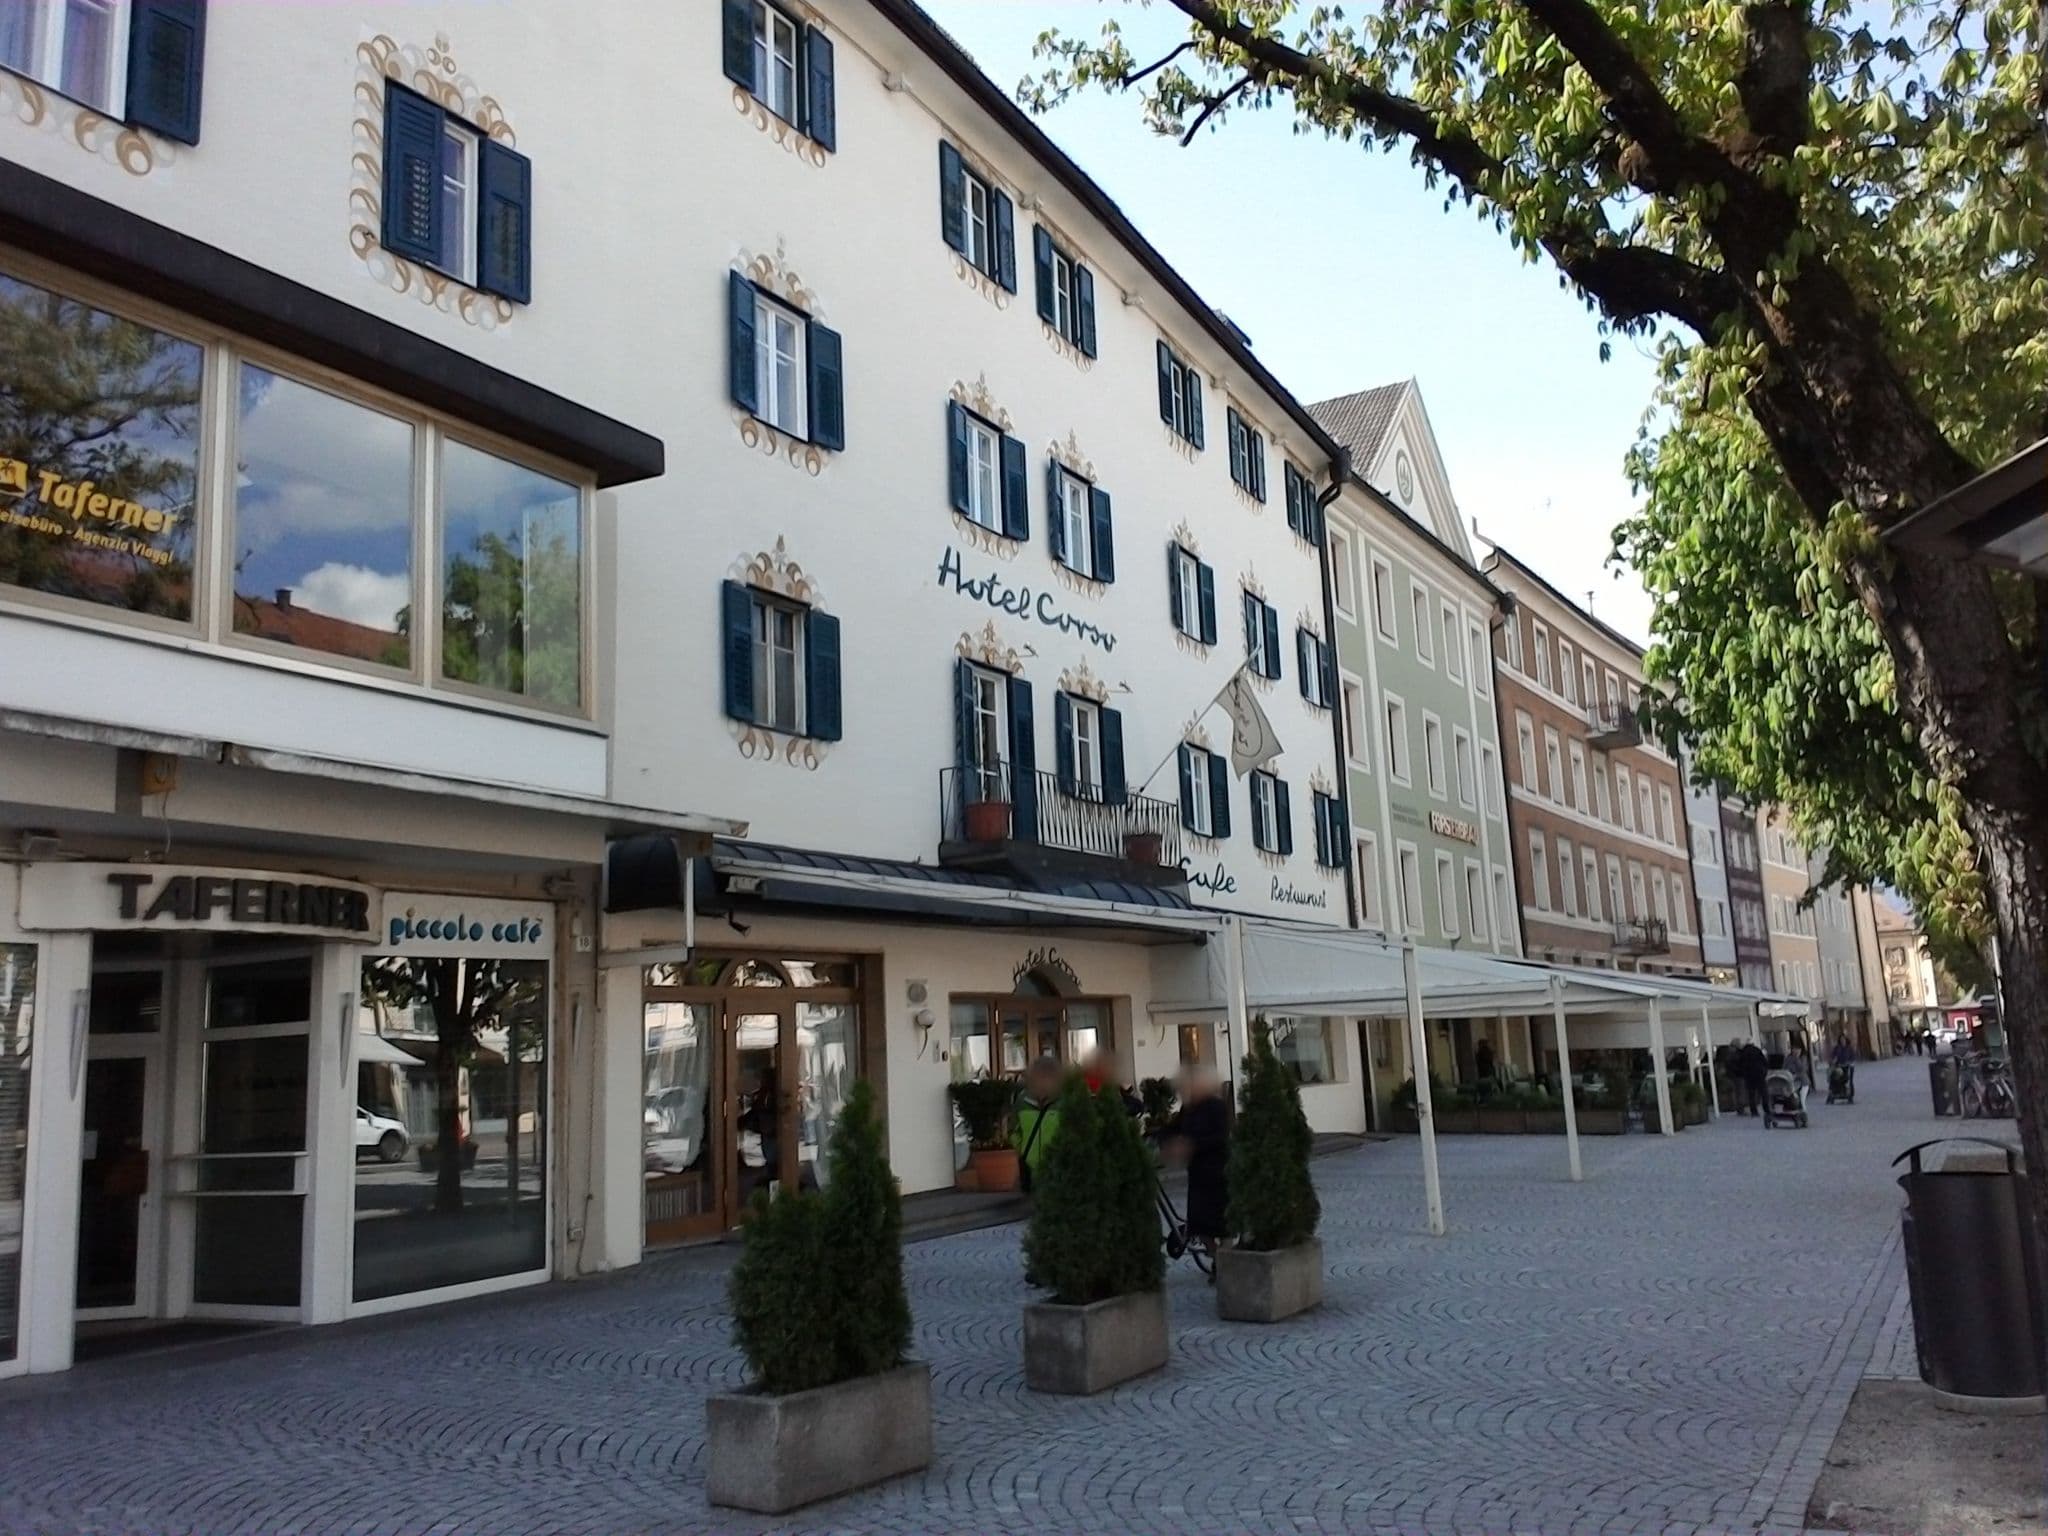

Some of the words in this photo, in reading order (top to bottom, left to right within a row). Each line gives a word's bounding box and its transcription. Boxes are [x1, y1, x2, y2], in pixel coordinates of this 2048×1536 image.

[38, 469, 179, 536] Taferner
[73, 527, 129, 552] Agenzia
[132, 540, 174, 566] Viaggi
[938, 545, 1030, 620] Hotel
[1036, 592, 1117, 653] Corso
[107, 873, 370, 931] TAFERNER
[390, 907, 484, 946] piccolo
[579, 936, 591, 949] 18
